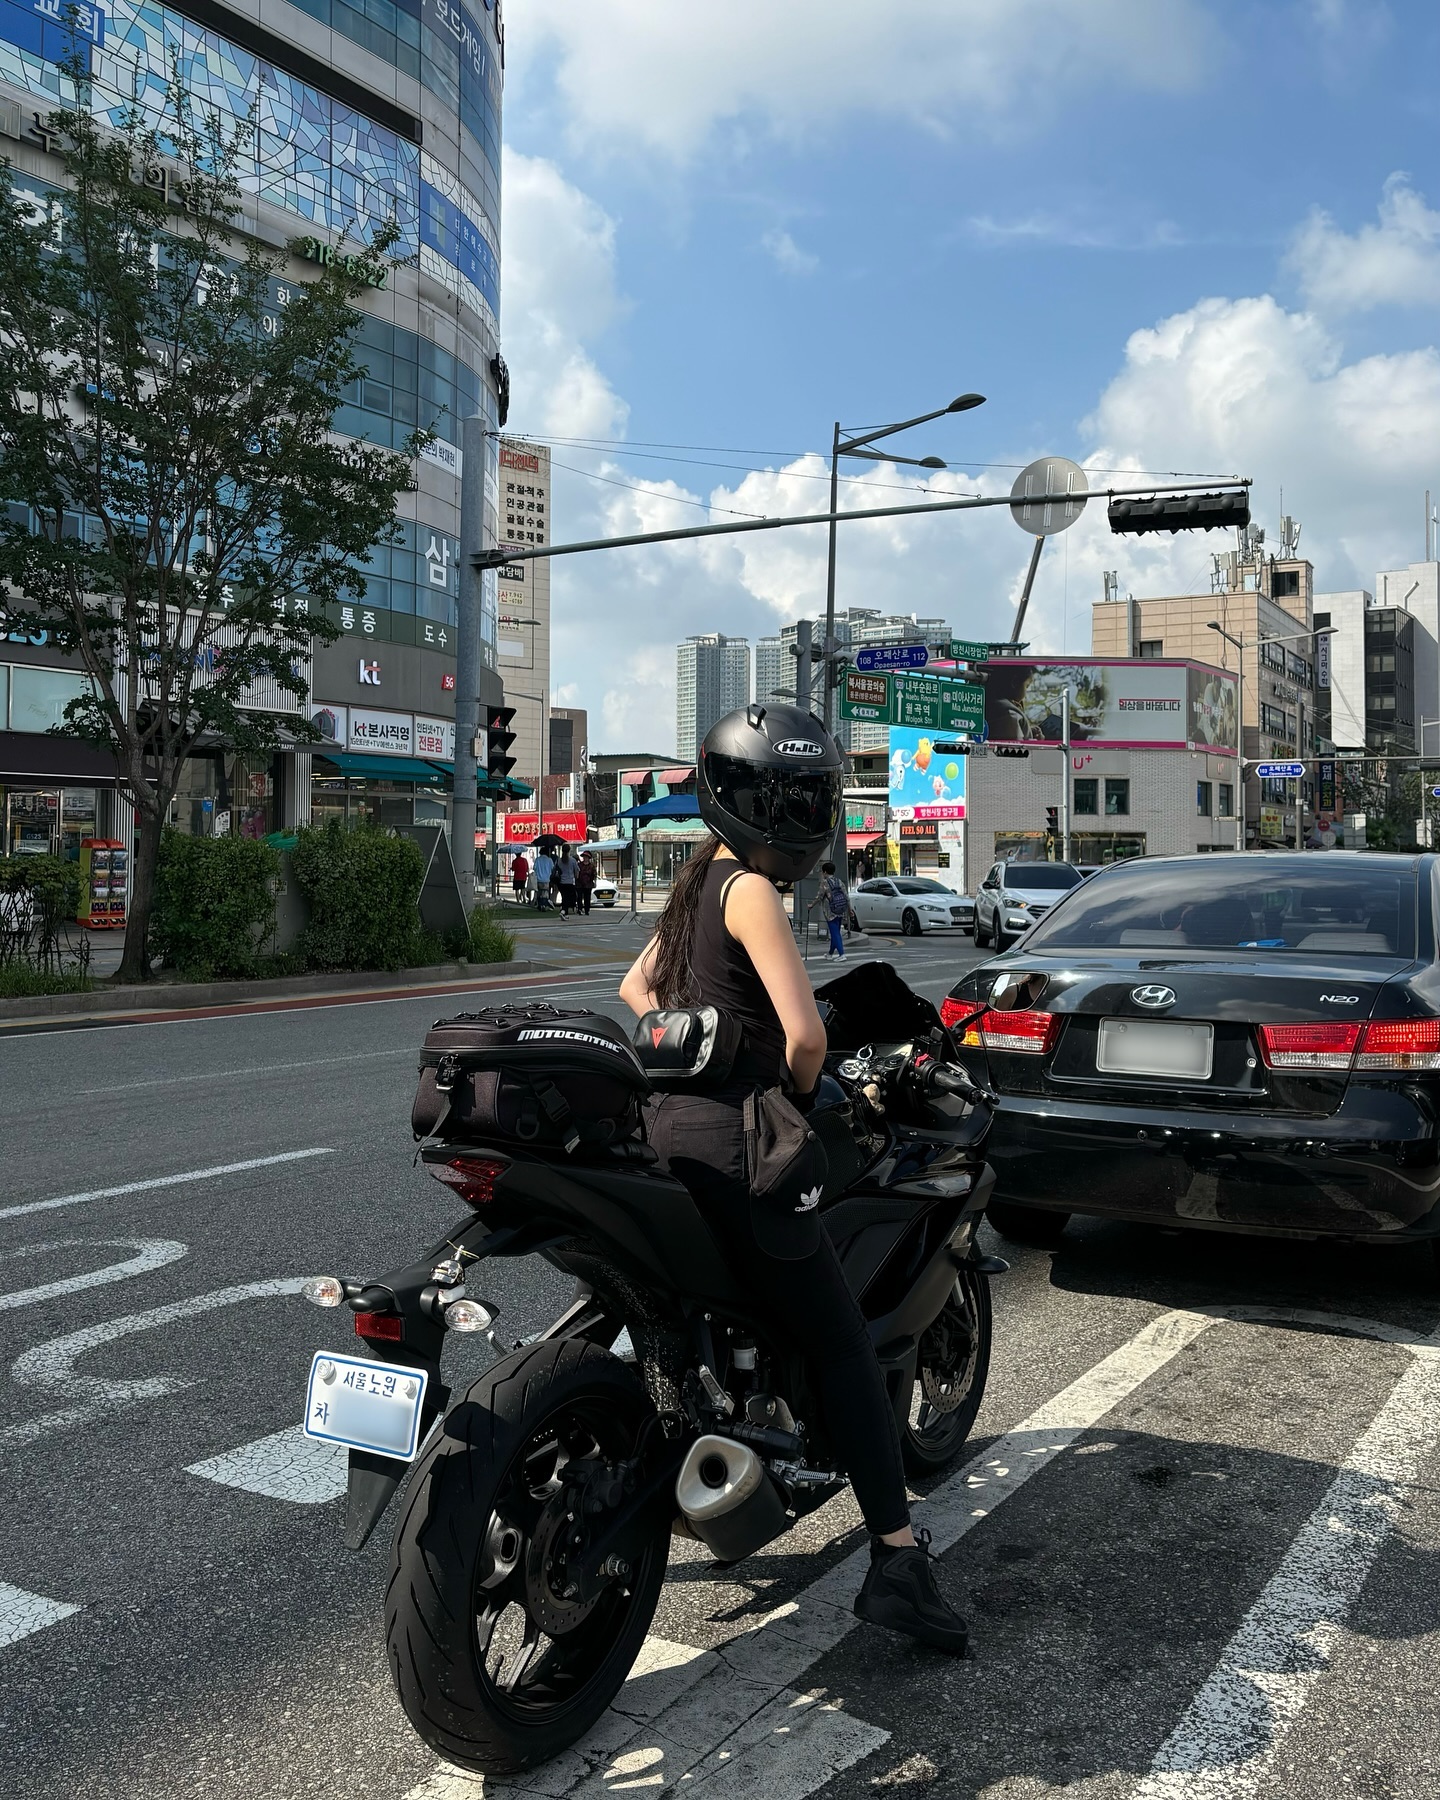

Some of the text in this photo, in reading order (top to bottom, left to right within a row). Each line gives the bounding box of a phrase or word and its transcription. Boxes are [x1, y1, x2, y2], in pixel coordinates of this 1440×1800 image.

[34, 0, 99, 42] 교회
[506, 498, 545, 513] 인공관절
[507, 514, 545, 529] 골절수술
[507, 529, 544, 543] 통증재활
[341, 607, 376, 633] 통증
[424, 625, 447, 648] 도수
[860, 649, 925, 665] 108 오패산로 112
[952, 643, 988, 659] 방천시장입구
[360, 659, 381, 685] kt
[873, 661, 911, 669] Opaesan-ro
[445, 677, 453, 688] 5G
[848, 677, 885, 693] 북서울꿈의숲
[1321, 673, 1328, 686] 수학
[905, 681, 939, 694] 내부순환로
[905, 692, 939, 705] Naebu Ringway
[951, 691, 983, 706] 미아사거리
[905, 703, 931, 716] 월곡역
[951, 703, 983, 714] Mia Junction
[1145, 700, 1181, 712] 바꿉니다
[905, 715, 933, 725] Wolgok Stn
[417, 723, 445, 736] 인터넷+TV
[419, 735, 443, 753] 전문점
[782, 743, 820, 754] HJC
[1073, 754, 1093, 770] U+
[1322, 764, 1332, 781] 연세
[920, 807, 959, 817] 방천시장 입구점
[901, 826, 916, 835] FEEL
[916, 825, 925, 835] SO
[925, 825, 936, 835] ALL
[1320, 994, 1360, 1004] N20
[517, 1029, 623, 1053] MOTOCENTRIC
[314, 1402, 330, 1426] 차
